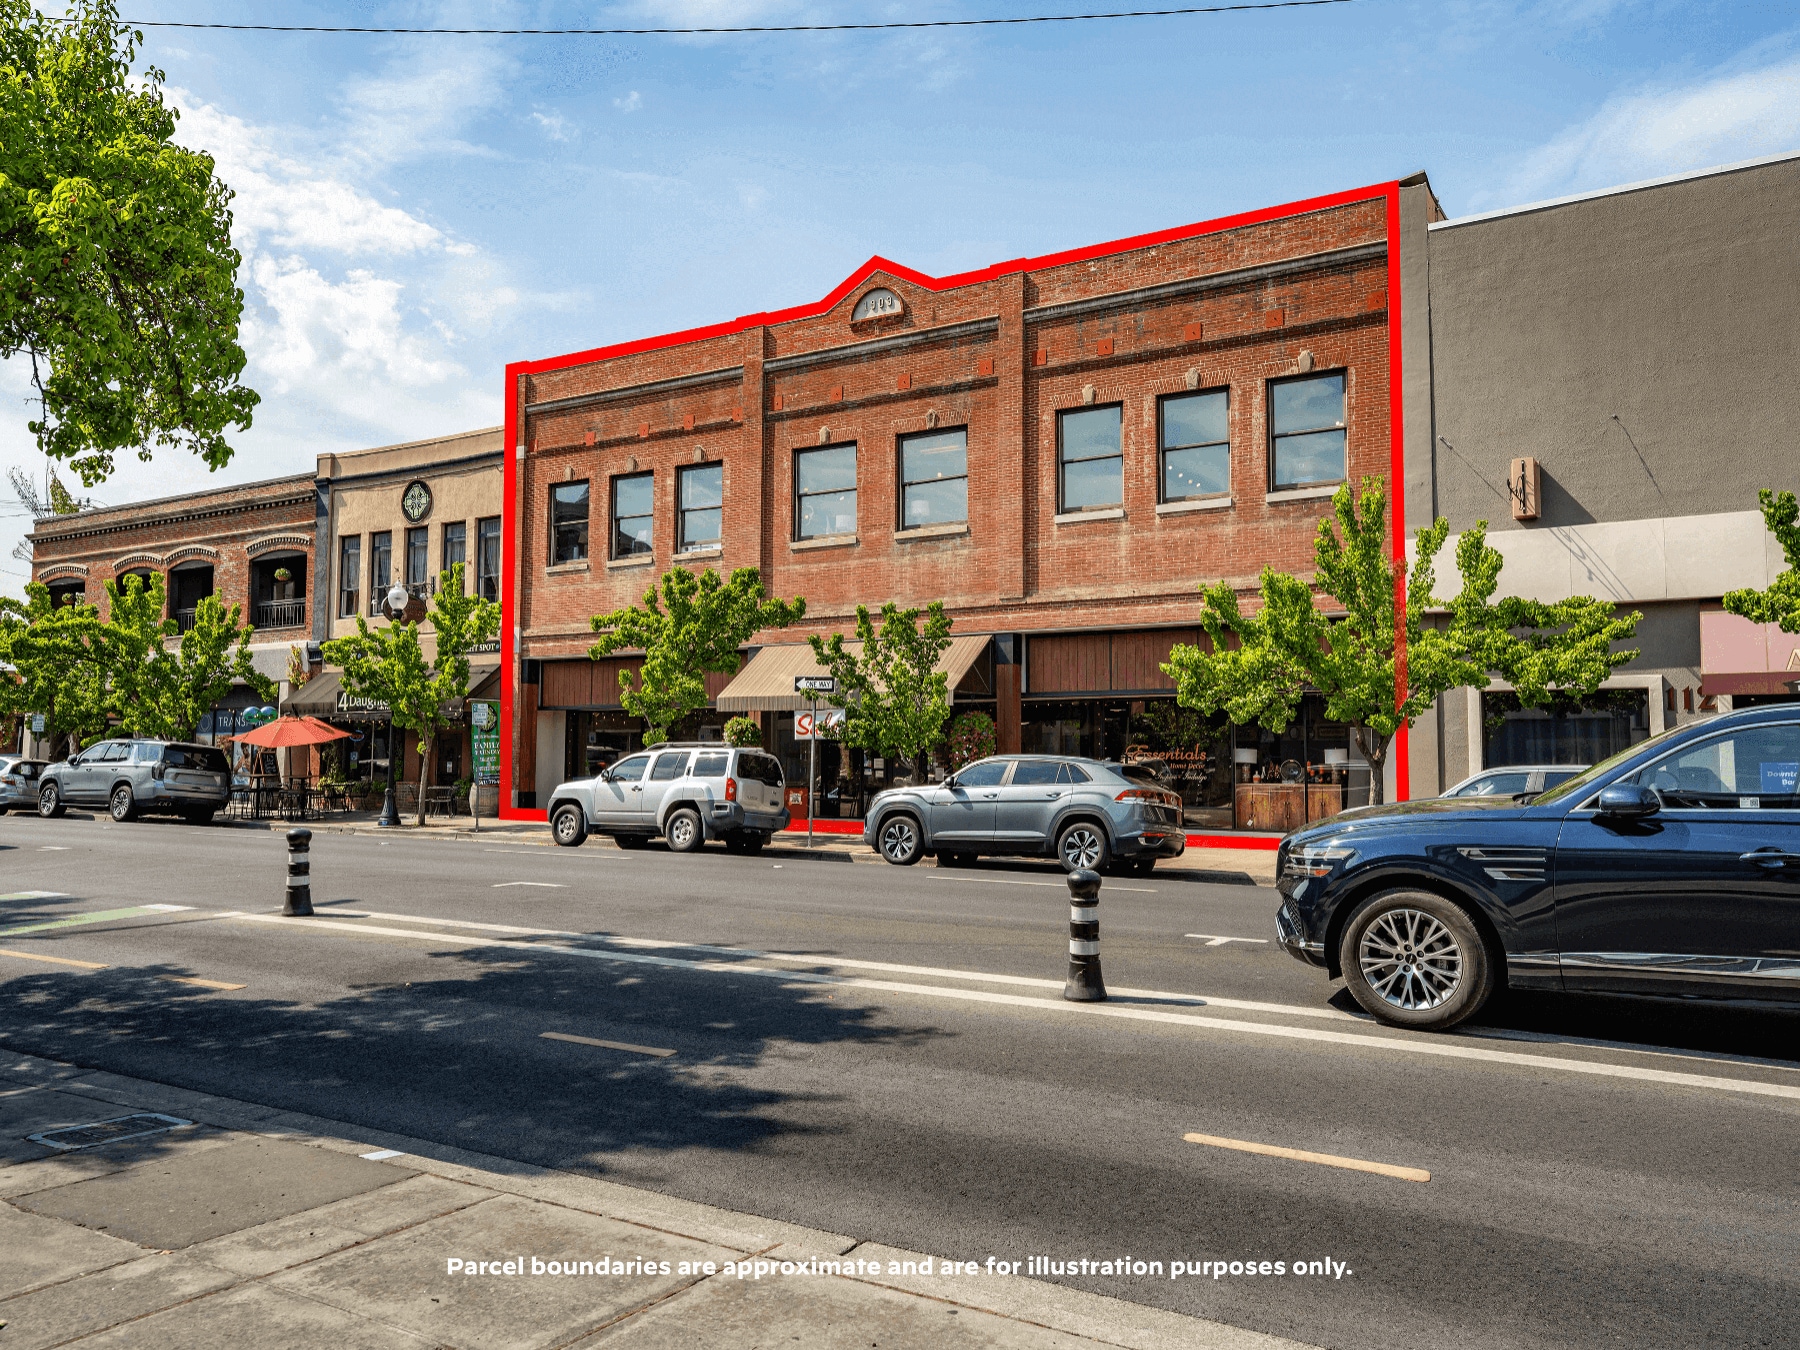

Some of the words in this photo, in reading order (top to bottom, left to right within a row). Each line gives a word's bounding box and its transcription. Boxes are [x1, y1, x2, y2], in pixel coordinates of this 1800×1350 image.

[863, 295, 893, 312] 1909
[479, 643, 495, 651] SPOT
[338, 692, 348, 711] 4
[1666, 685, 1716, 711] 112
[1126, 743, 1206, 761] Essentials
